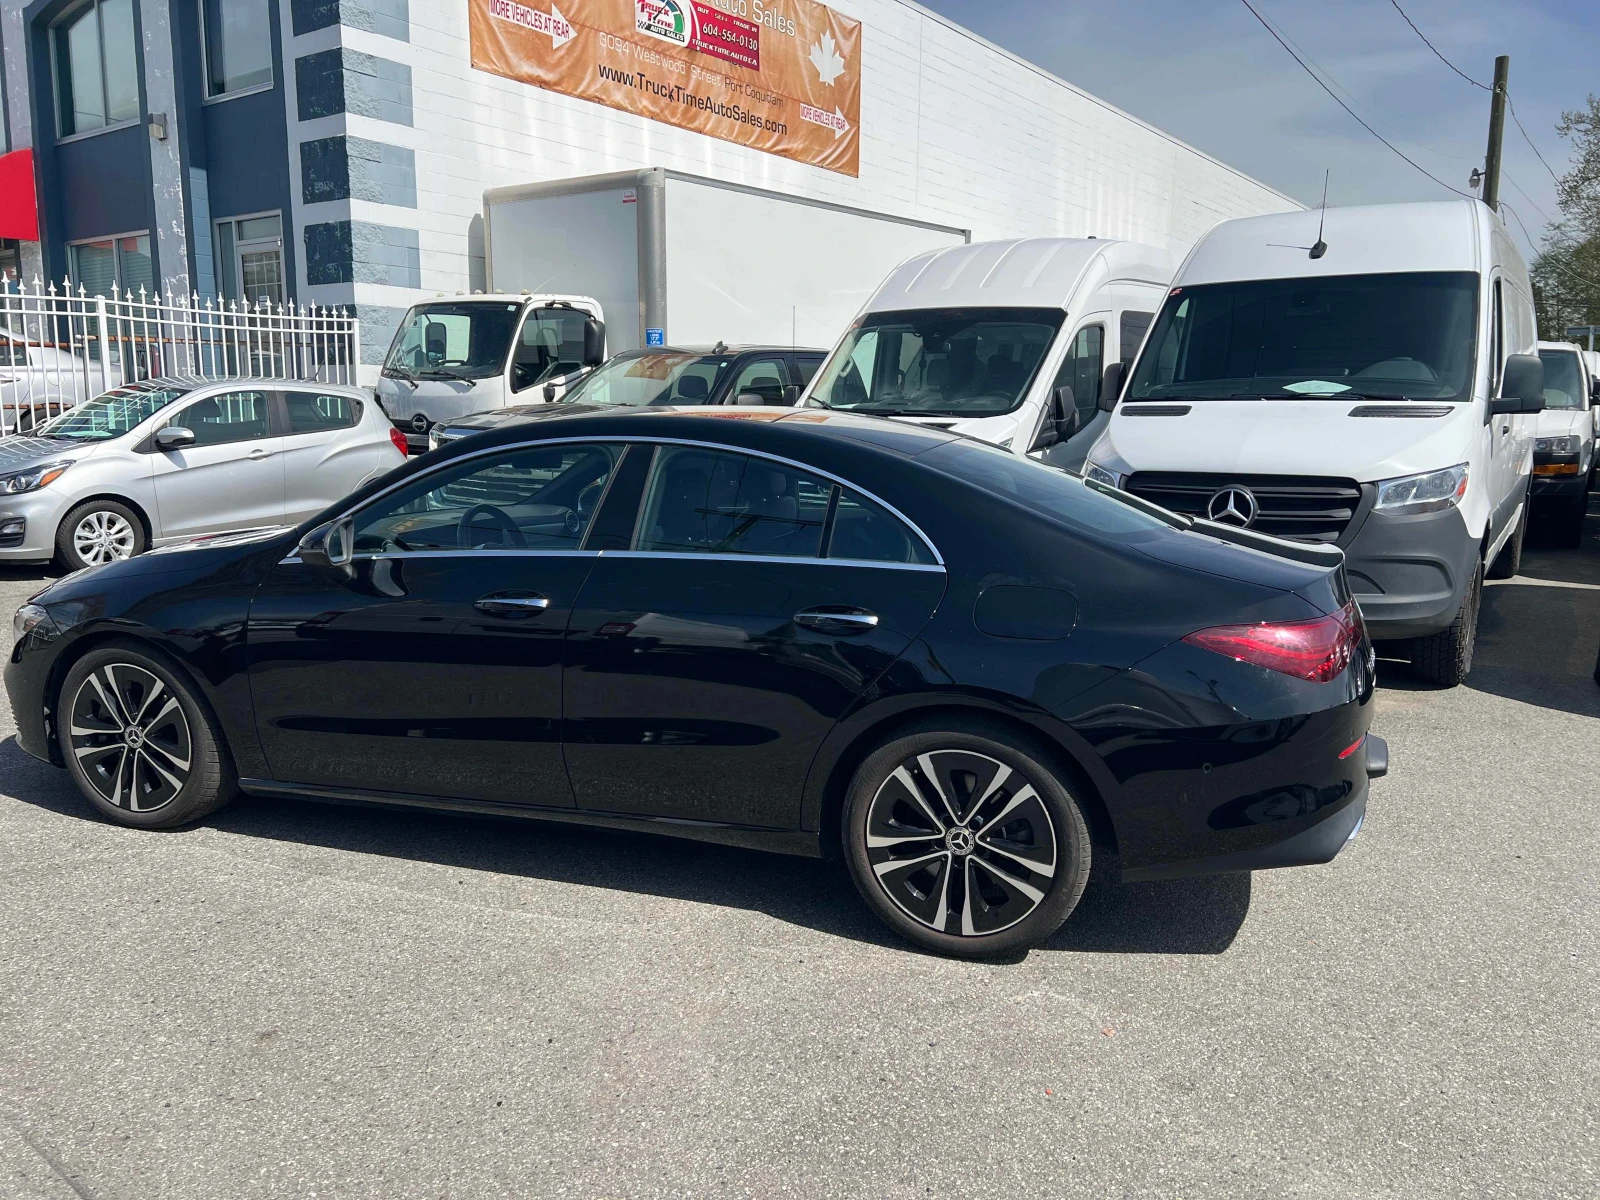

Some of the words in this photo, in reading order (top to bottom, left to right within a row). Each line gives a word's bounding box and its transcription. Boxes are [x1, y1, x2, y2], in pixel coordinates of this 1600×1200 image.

[490, 0, 510, 19] MORE
[511, 4, 542, 29] VEHICLES
[544, 17, 552, 33] AT
[553, 19, 570, 39] REAR
[650, 25, 665, 34] AUTO
[666, 30, 684, 40] SALES
[697, 6, 709, 14] BUY
[733, 20, 750, 30] TRADE
[752, 0, 796, 37] Sales
[702, 22, 758, 51] 604-554-0130
[632, 43, 686, 75] Westwood
[690, 64, 722, 87] Street
[724, 76, 743, 95] Port
[598, 64, 788, 136] www.TruckTimeAutoSales.com
[801, 105, 812, 120] MORE
[812, 109, 830, 126] VEHICLES
[831, 115, 836, 128] AT
[836, 117, 846, 131] REAR
